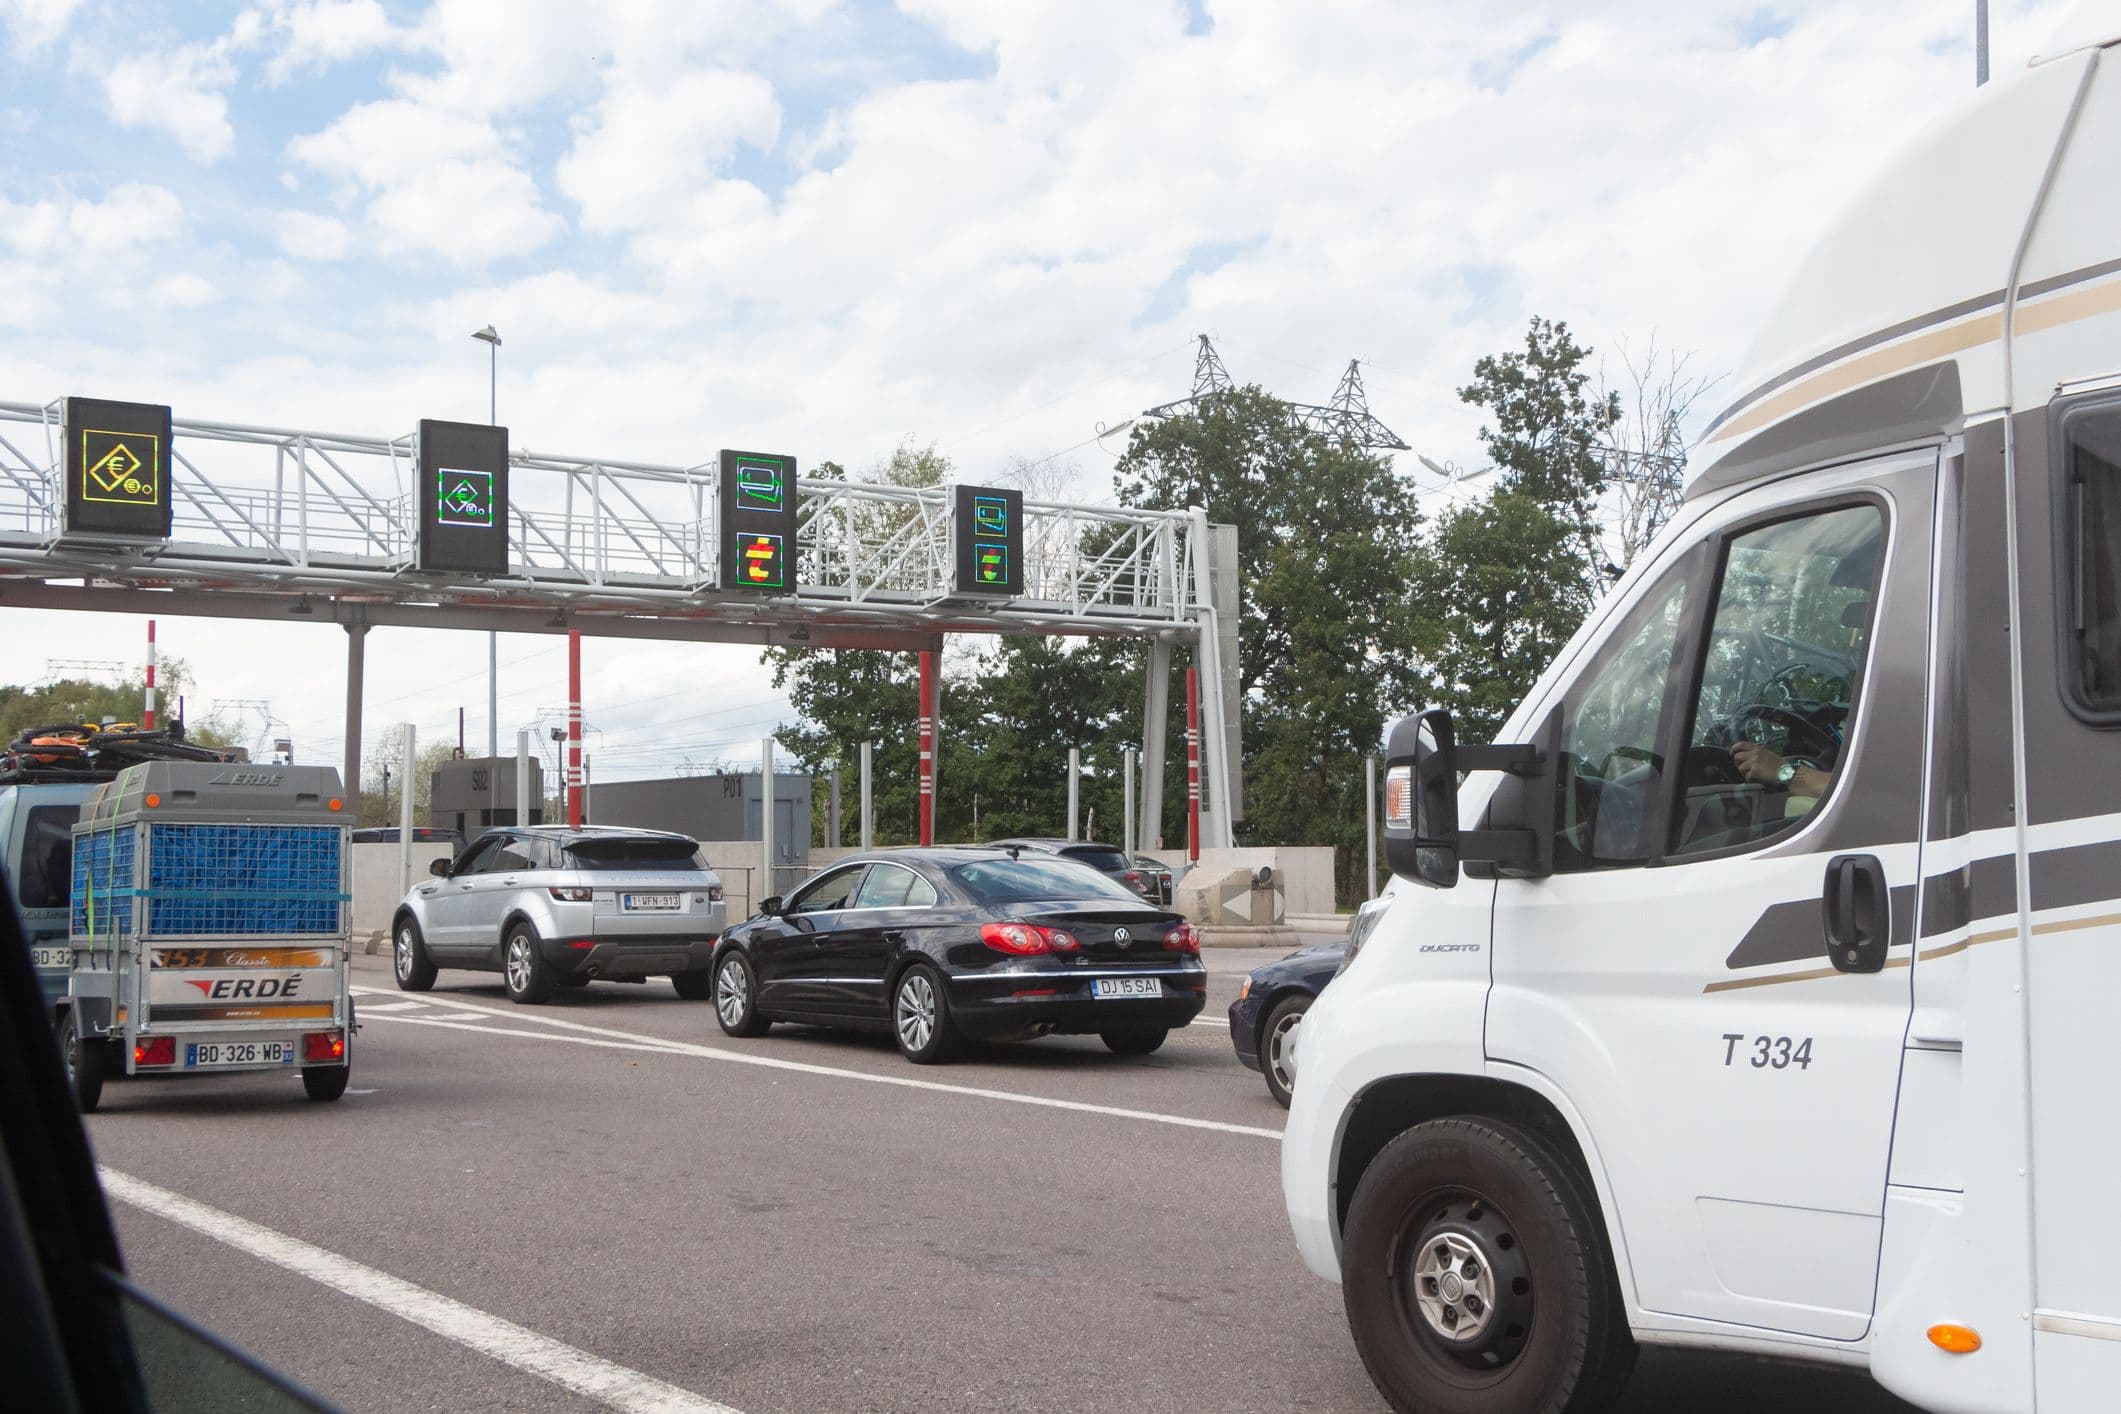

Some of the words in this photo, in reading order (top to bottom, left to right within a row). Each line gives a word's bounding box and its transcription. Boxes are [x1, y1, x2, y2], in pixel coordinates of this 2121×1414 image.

[472, 769, 488, 791] S02
[1419, 944, 1480, 952] DUCATO
[223, 951, 272, 967] Classic
[211, 973, 303, 999] ERDÉ
[1101, 980, 1118, 994] DJ
[1120, 980, 1133, 993] 15
[199, 1043, 282, 1063] BD-326-WB
[1722, 1033, 1744, 1066] T
[1750, 1035, 1813, 1070] 334
